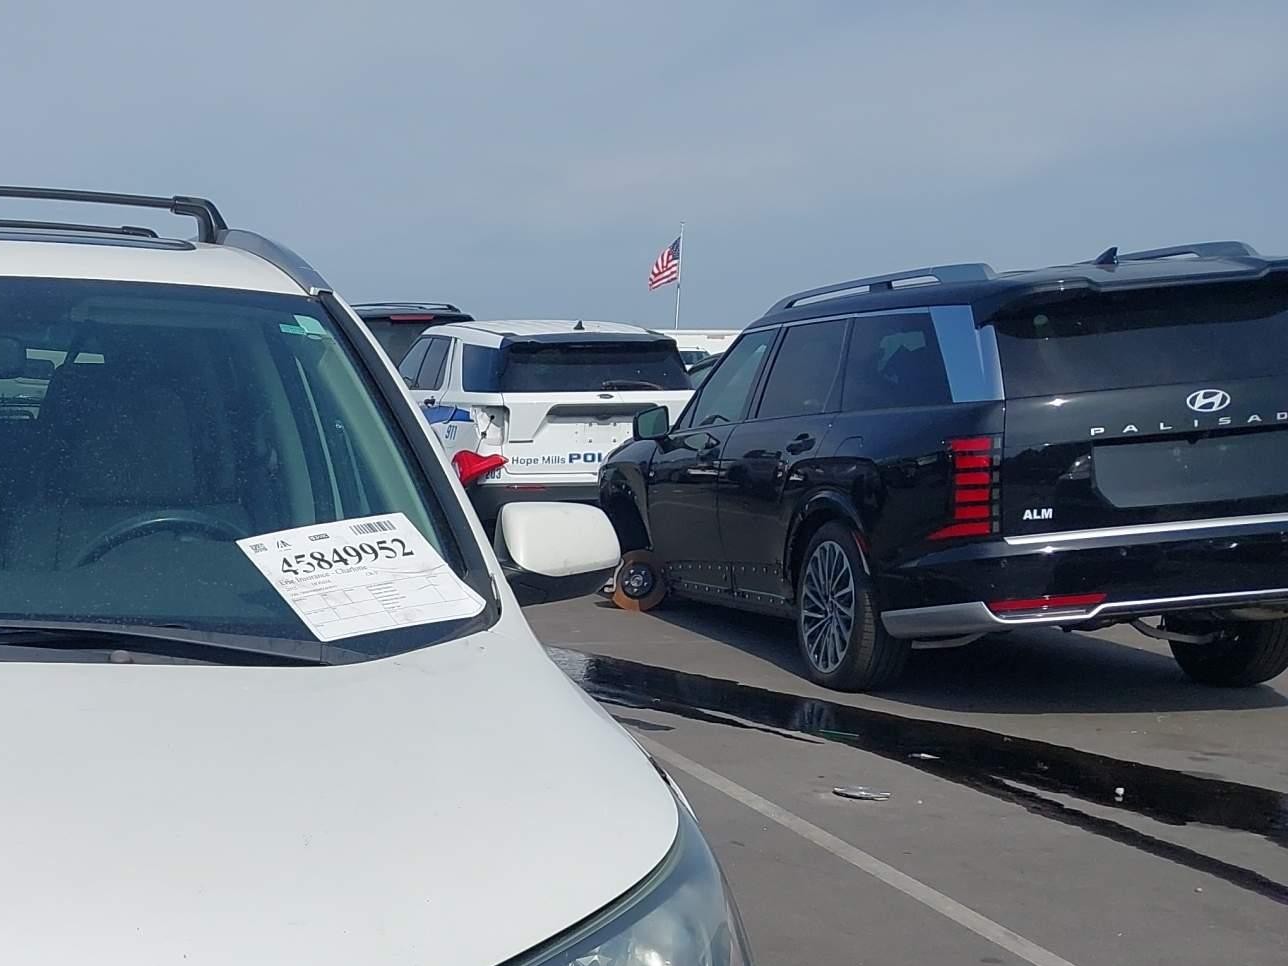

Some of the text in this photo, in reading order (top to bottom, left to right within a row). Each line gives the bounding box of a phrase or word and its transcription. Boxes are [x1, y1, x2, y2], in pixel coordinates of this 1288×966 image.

[444, 425, 458, 440] 911
[511, 456, 539, 467] Hope
[542, 455, 566, 465] Mills
[1023, 508, 1053, 520] ALM
[281, 538, 414, 575] 45849952
